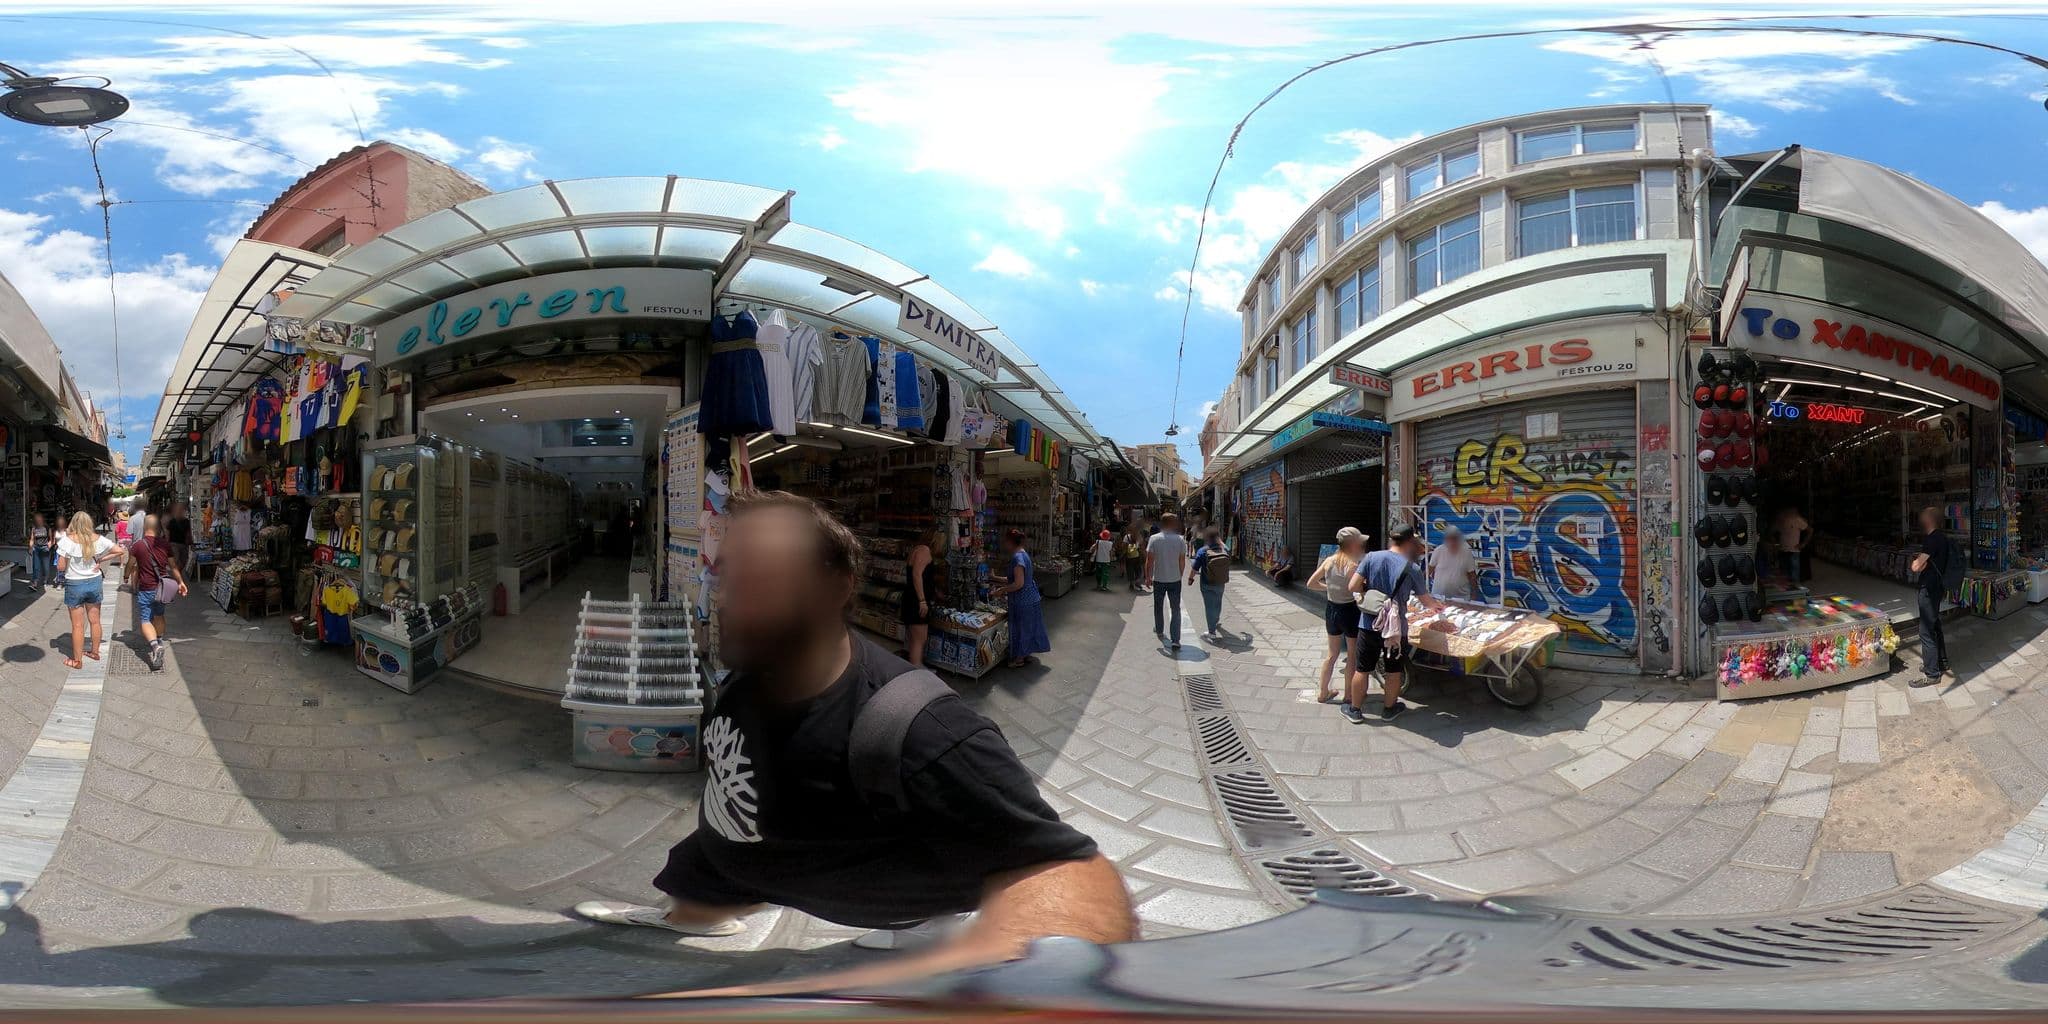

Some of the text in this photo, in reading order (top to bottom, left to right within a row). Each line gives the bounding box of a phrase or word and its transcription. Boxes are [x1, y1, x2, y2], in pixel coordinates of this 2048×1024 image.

[396, 285, 630, 355] eleven
[643, 305, 690, 315] IFESTOU
[906, 298, 996, 369] DIMITRA
[1335, 367, 1391, 392] ERRIS
[1412, 338, 1593, 399] ERRIS
[1617, 362, 1633, 371] 20
